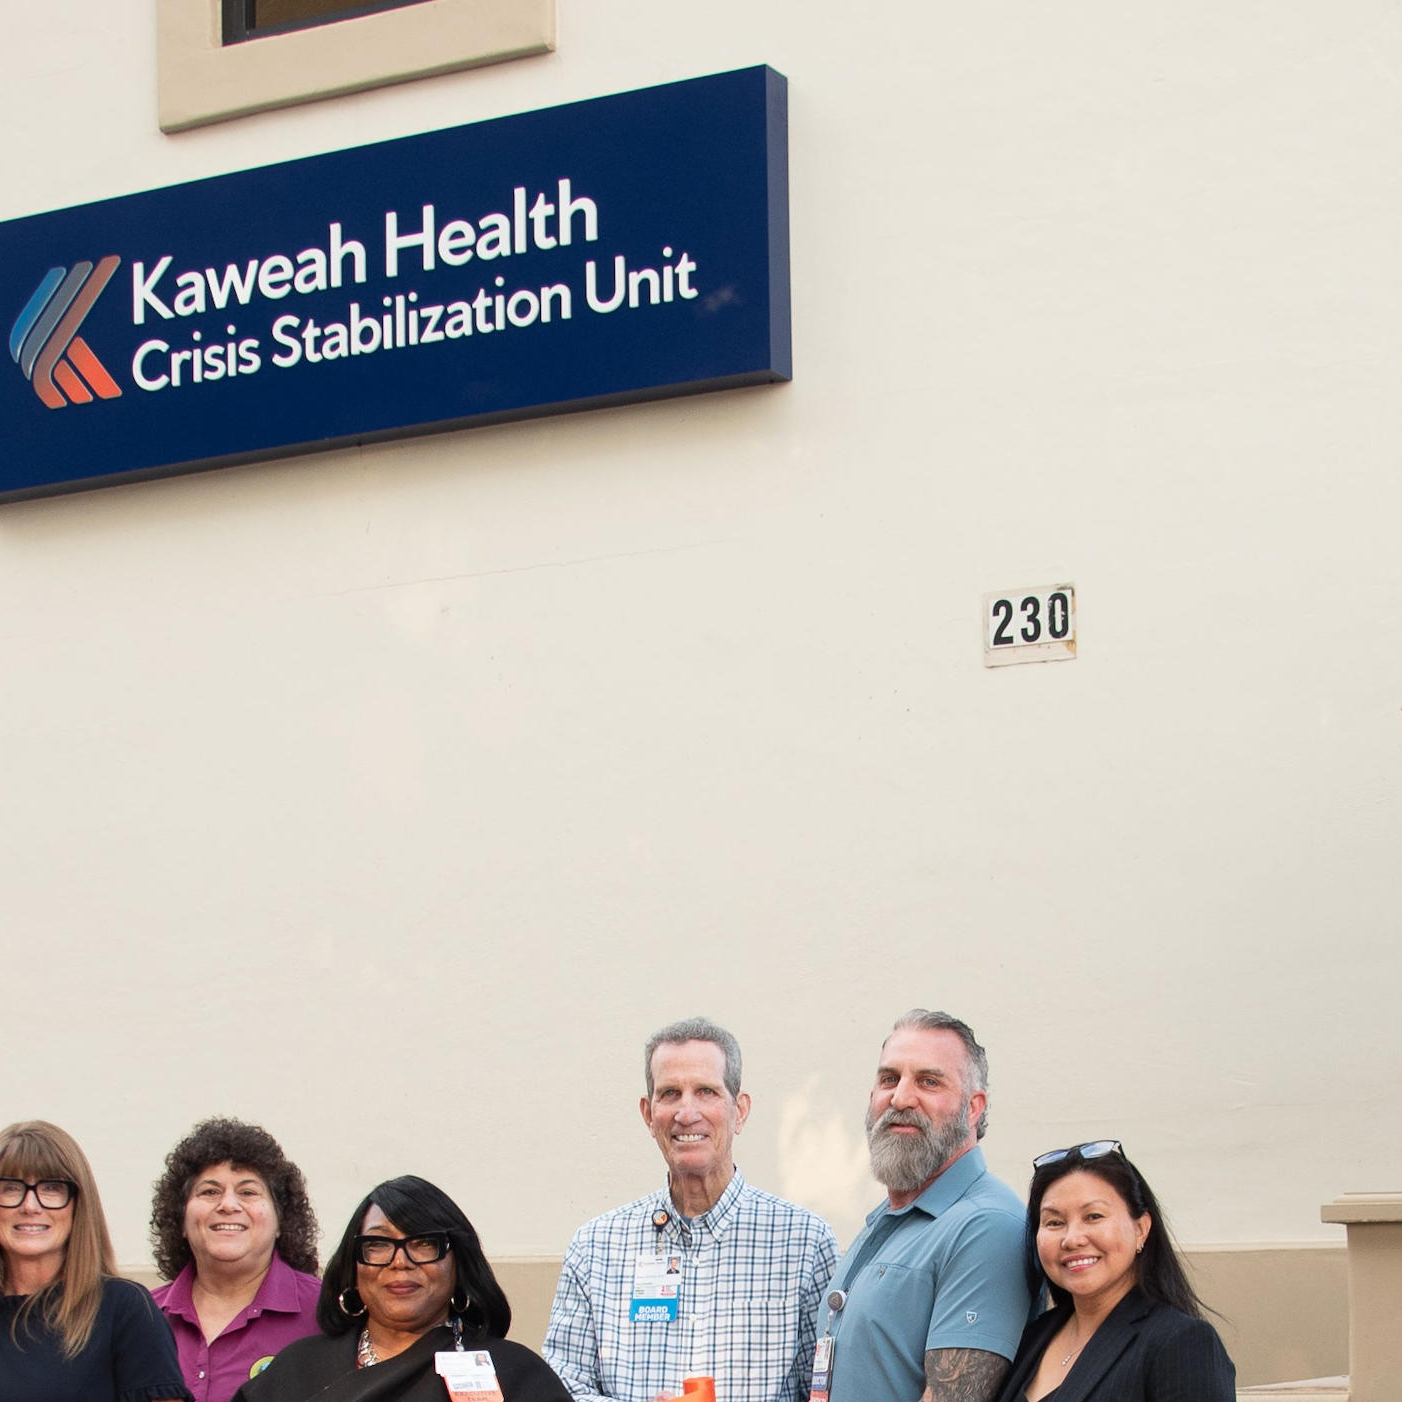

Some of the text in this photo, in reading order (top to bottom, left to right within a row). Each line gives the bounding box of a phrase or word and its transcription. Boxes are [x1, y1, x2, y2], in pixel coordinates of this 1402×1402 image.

[133, 178, 598, 325] Kaweah Health
[132, 246, 699, 391] Crisis Stabilization Unit
[992, 592, 1069, 646] 230
[635, 1313, 670, 1321] MEMBER
